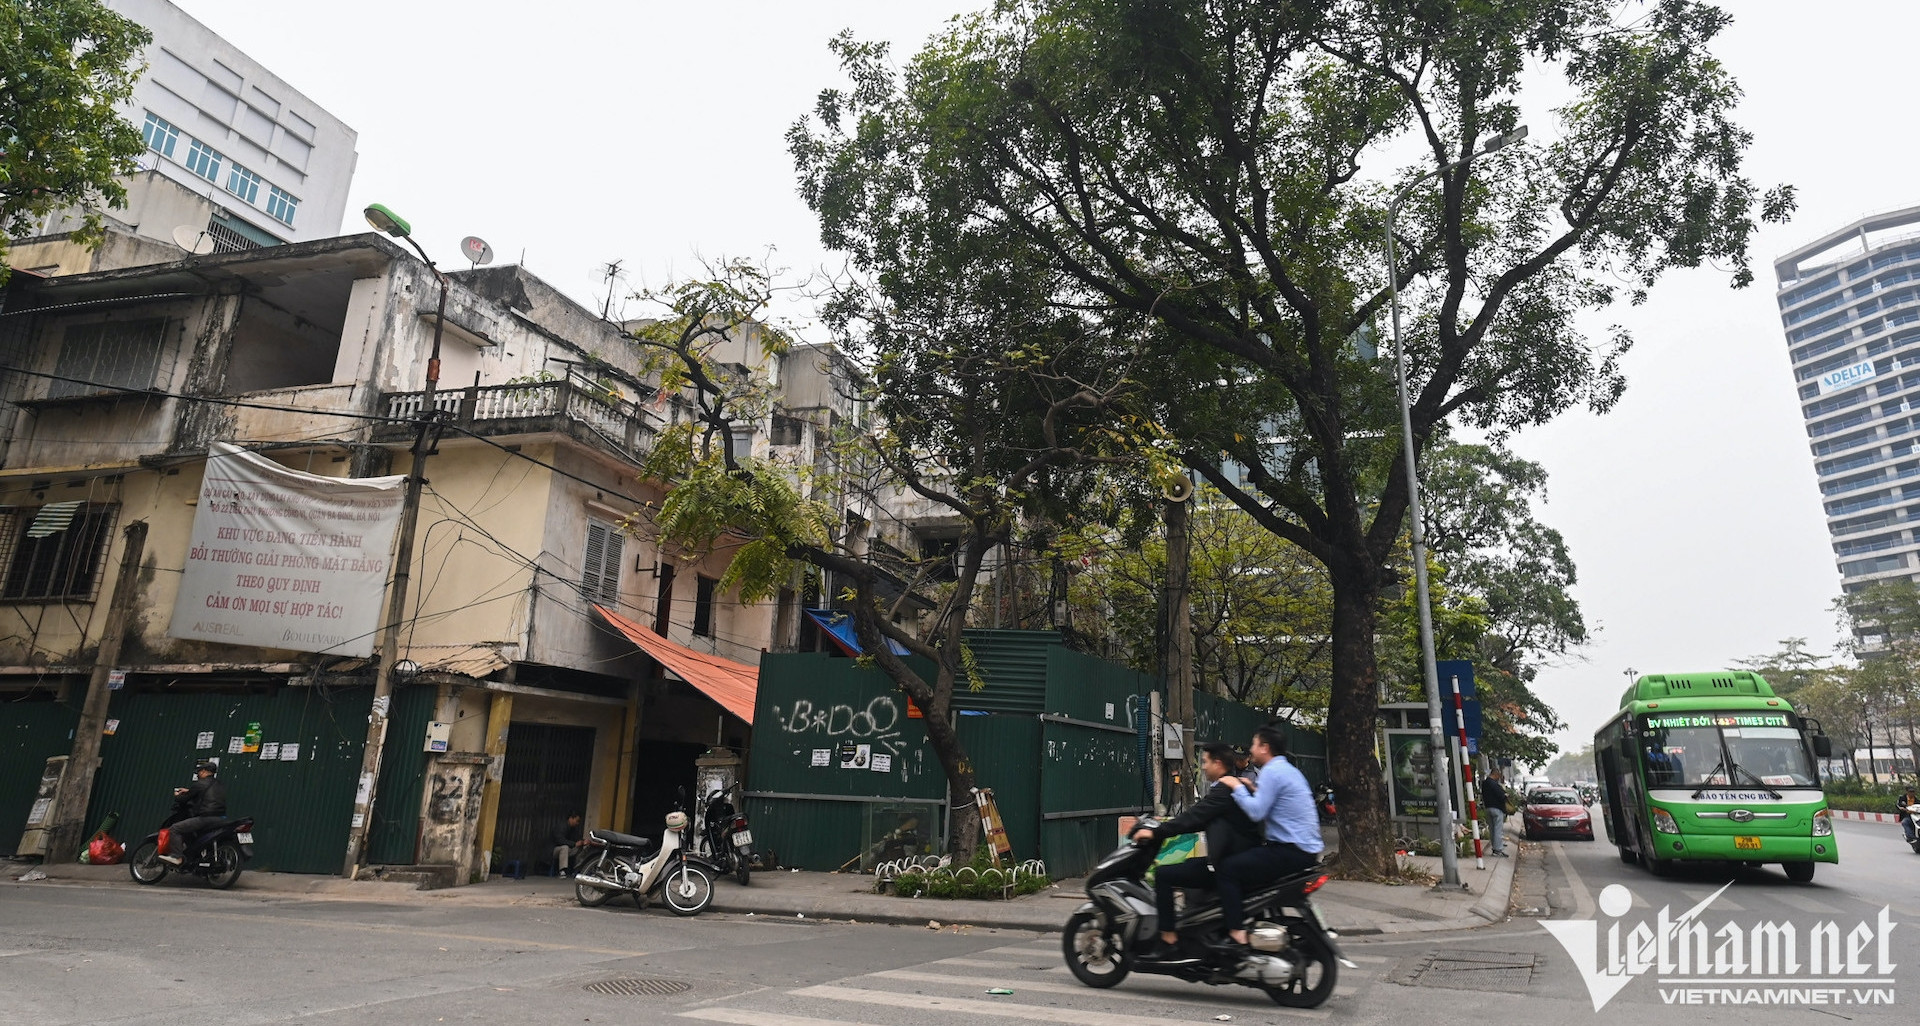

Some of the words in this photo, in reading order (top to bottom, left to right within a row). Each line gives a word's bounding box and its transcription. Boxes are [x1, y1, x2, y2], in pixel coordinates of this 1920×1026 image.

[1831, 362, 1872, 384] DELTA
[221, 504, 229, 513] 22
[327, 511, 337, 520] BA
[217, 527, 240, 540] KHU
[243, 528, 264, 544] VỰC
[266, 530, 296, 544] ĐANG
[300, 528, 328, 546] TIẾN
[329, 531, 363, 548] HÀNH
[211, 547, 253, 564] THƯỜNG
[256, 549, 280, 566] GIẢI
[281, 552, 320, 570] PHÓNG
[322, 554, 348, 573] MẶT
[236, 574, 265, 589] THEO
[267, 577, 290, 593] QUY
[292, 579, 321, 595] ĐỊNH
[206, 590, 230, 609] CẢM
[232, 595, 247, 611] ƠN
[249, 599, 271, 616] MỌI
[273, 600, 289, 617] SỰ
[290, 601, 314, 619] HỢP
[317, 601, 343, 619] TÁC!
[1692, 715, 1711, 727] ĐỚI
[1735, 716, 1763, 726] TIMES
[1766, 715, 1788, 726] CITY
[432, 774, 463, 799] 22
[1758, 793, 1776, 801] BUS
